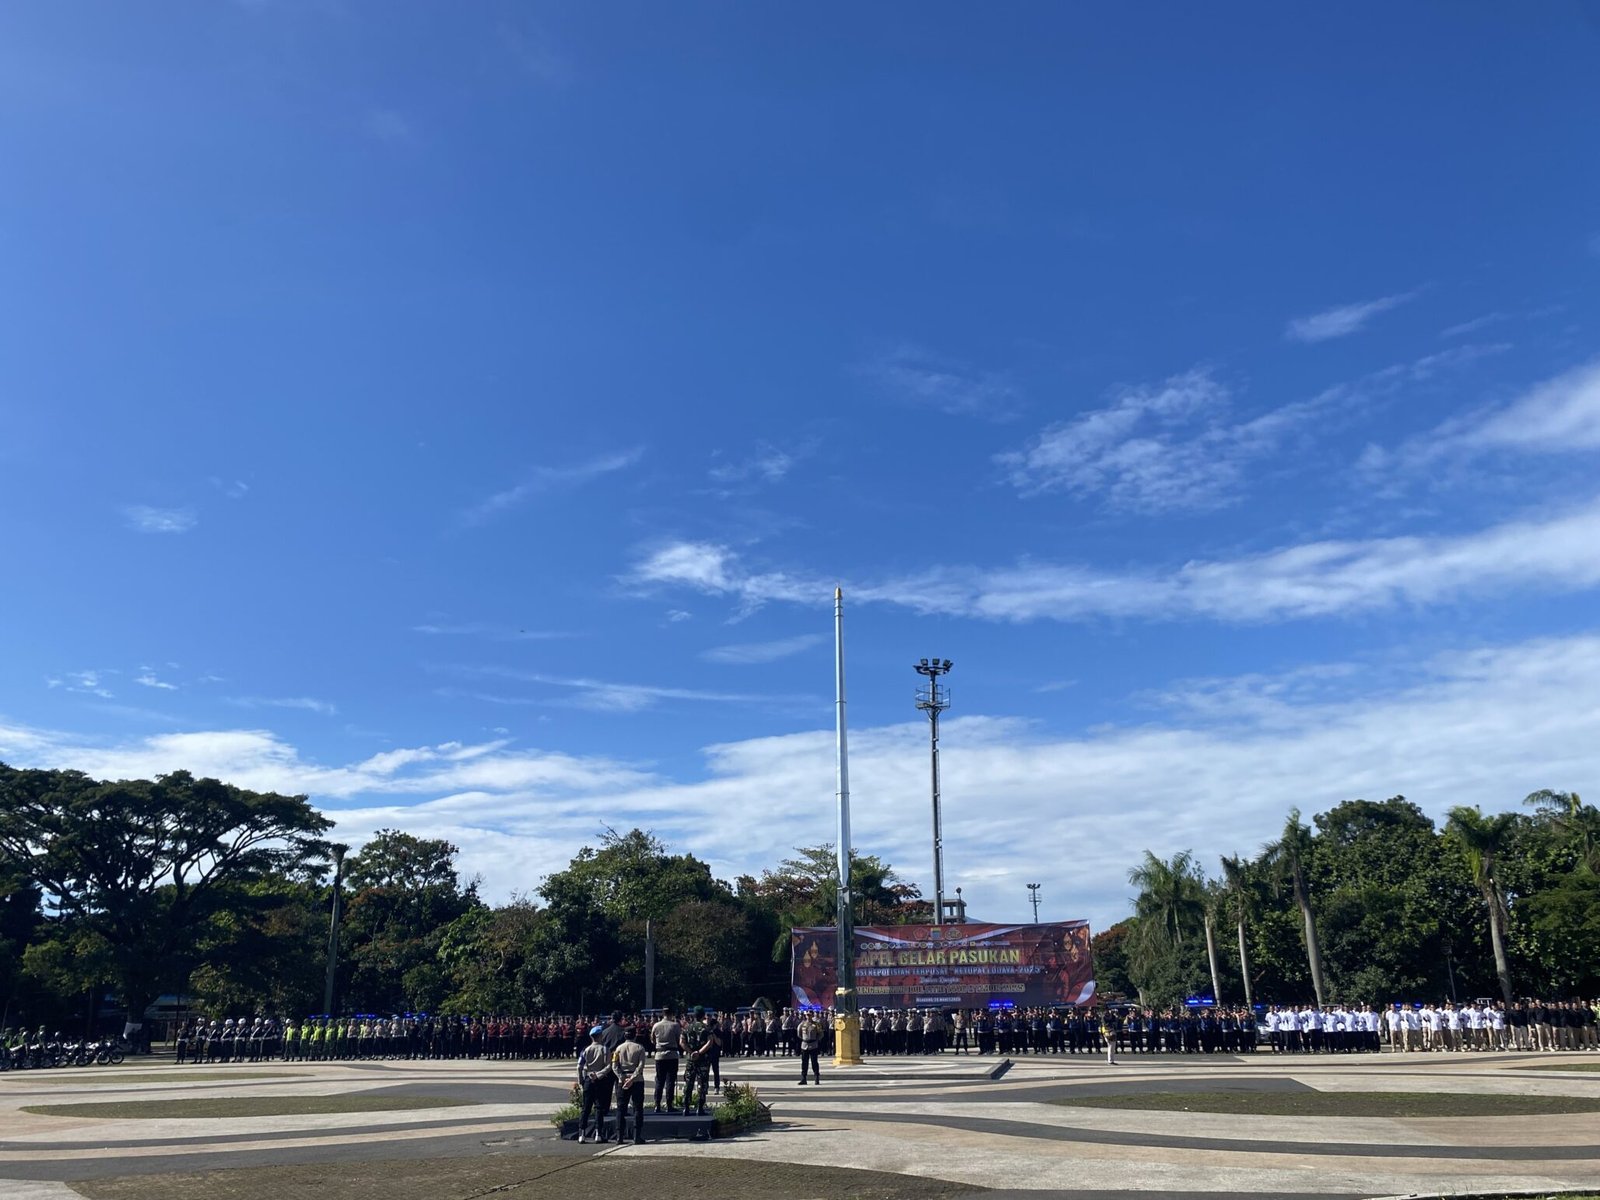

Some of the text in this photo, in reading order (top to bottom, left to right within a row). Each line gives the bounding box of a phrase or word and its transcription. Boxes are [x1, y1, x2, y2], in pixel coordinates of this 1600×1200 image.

[860, 949, 1020, 966] APEL GELAR PASUKAN
[912, 966, 948, 976] TERPUSAT
